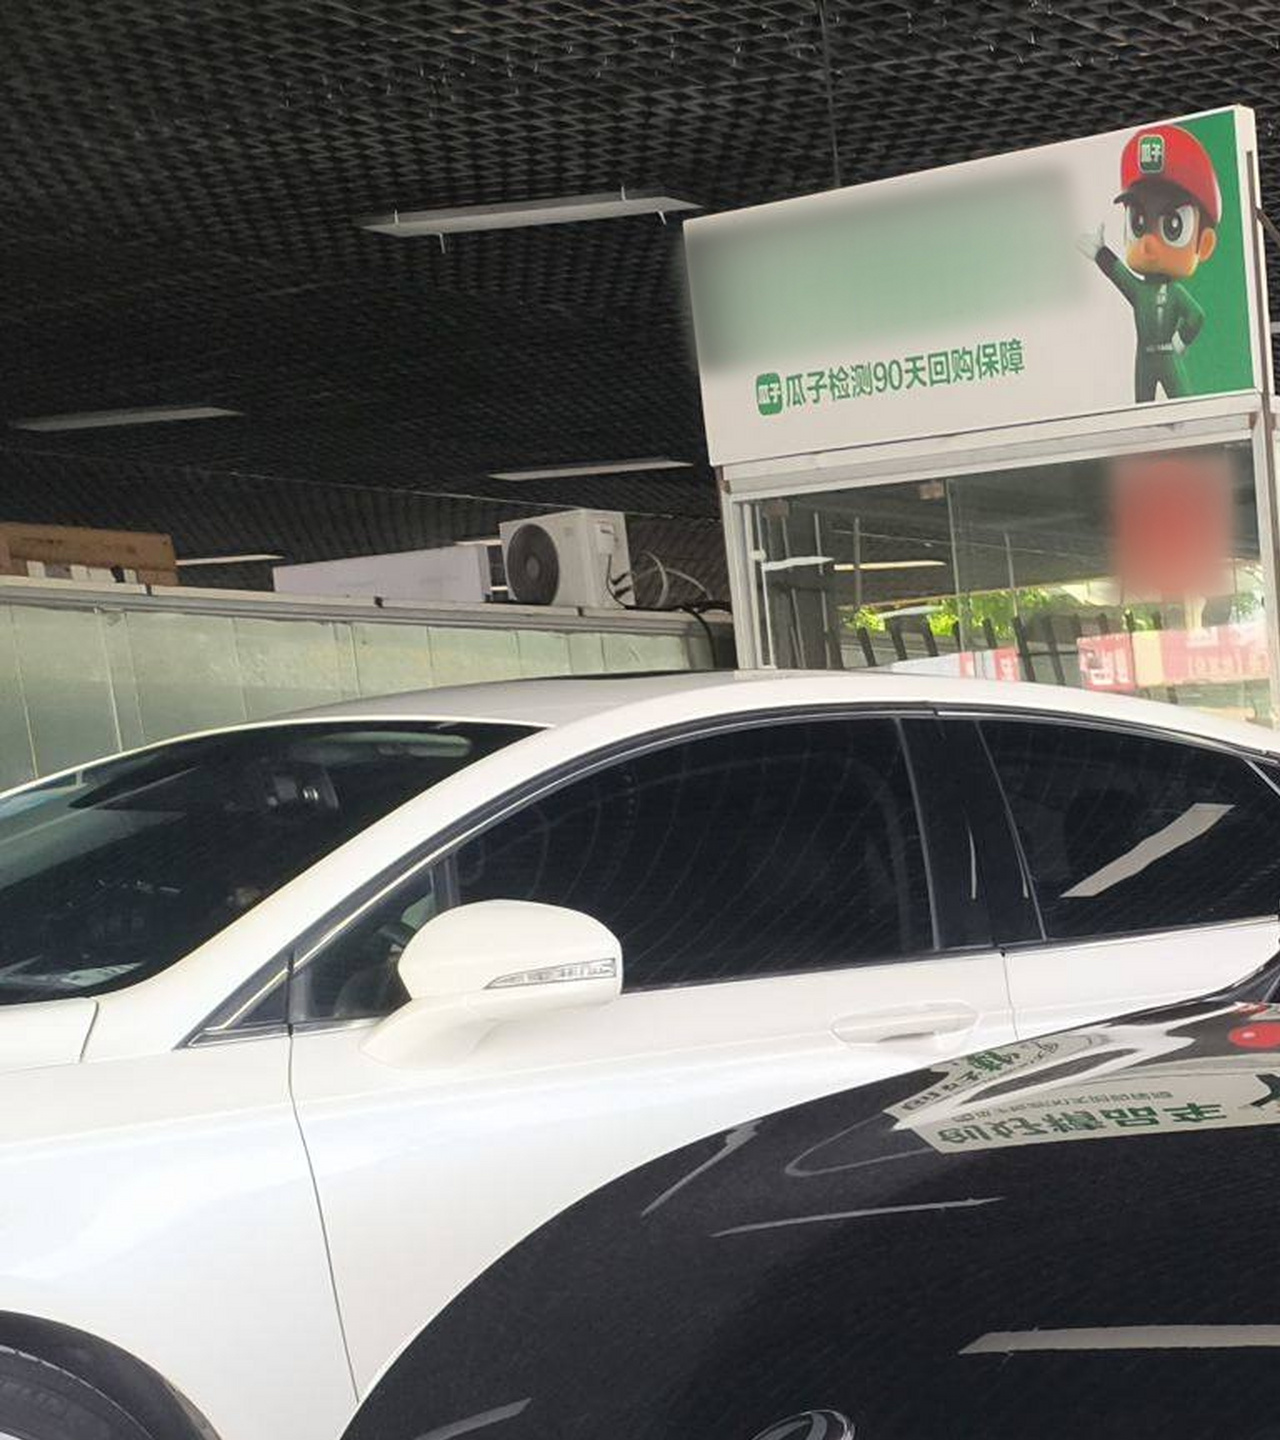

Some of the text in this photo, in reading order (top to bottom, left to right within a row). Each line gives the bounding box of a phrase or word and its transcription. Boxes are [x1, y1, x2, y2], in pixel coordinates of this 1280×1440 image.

[786, 339, 1025, 407] 瓜子检测90天回购保障
